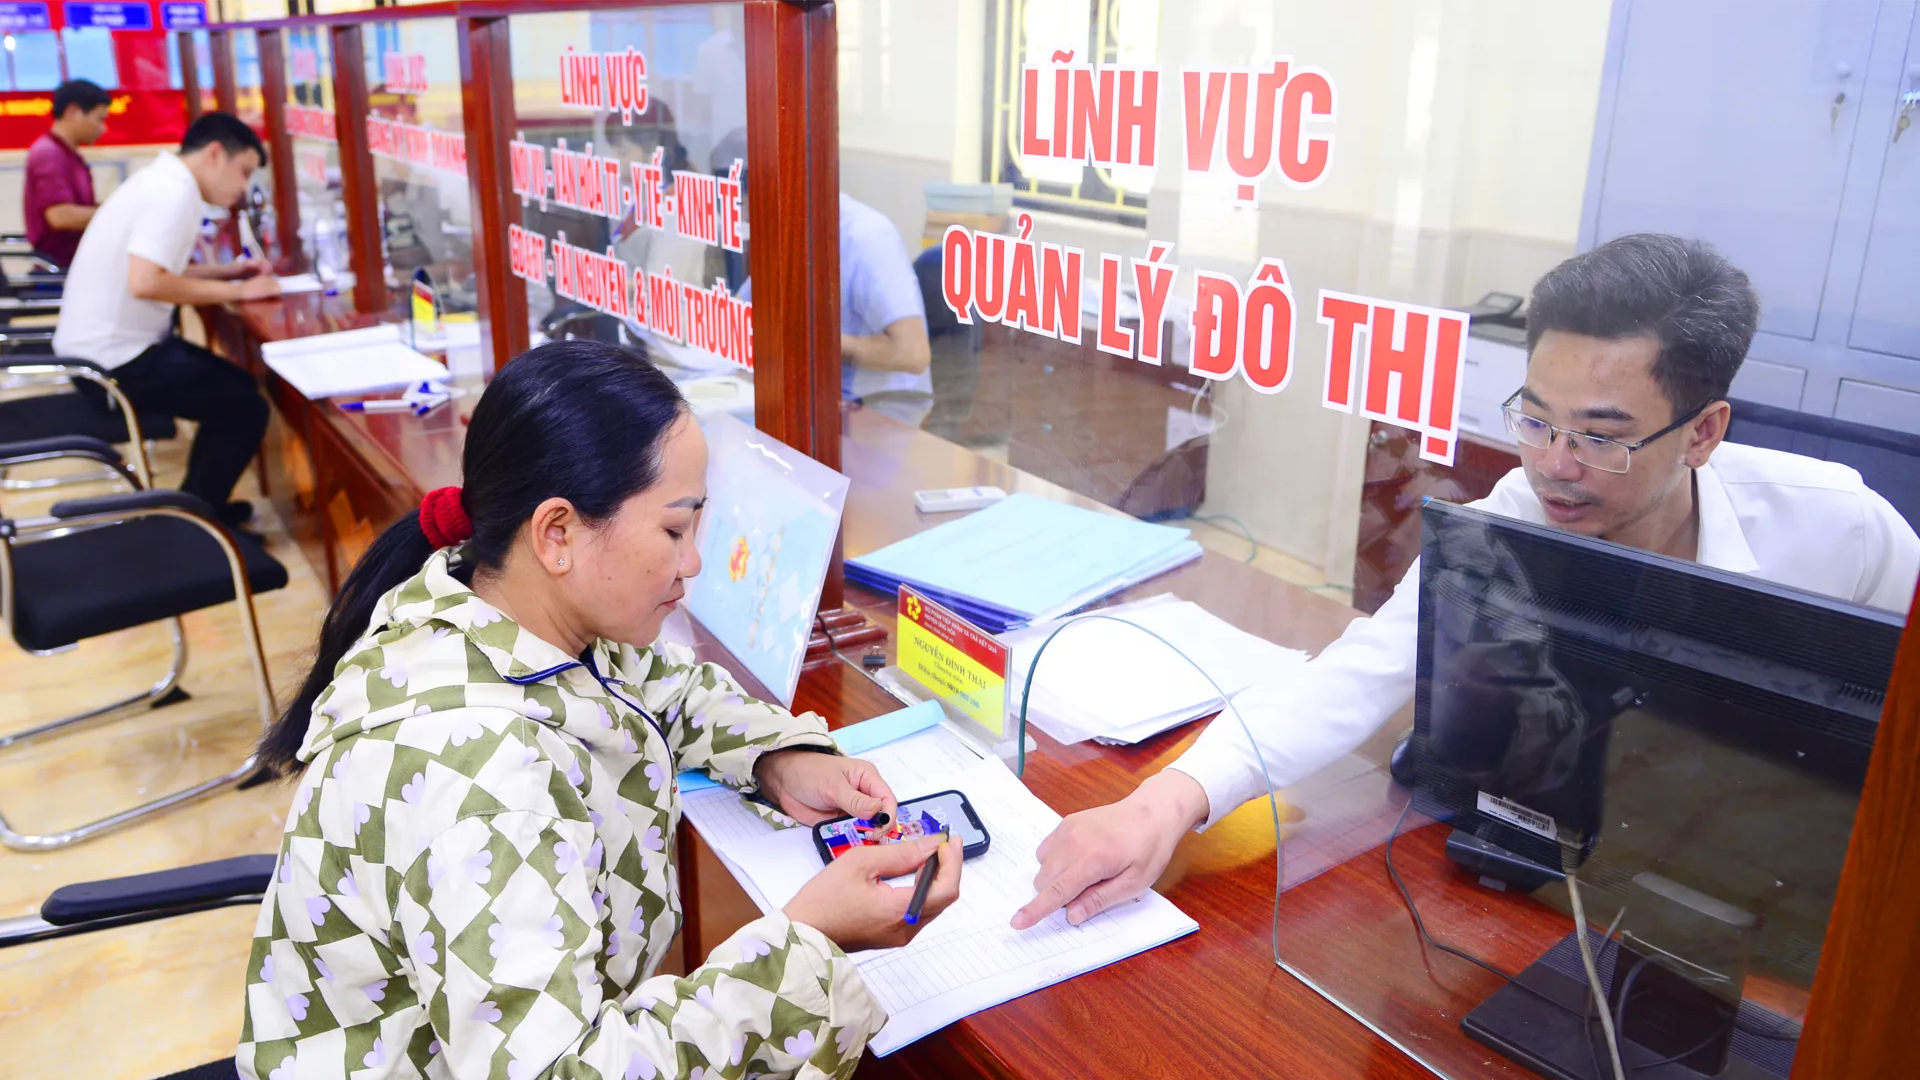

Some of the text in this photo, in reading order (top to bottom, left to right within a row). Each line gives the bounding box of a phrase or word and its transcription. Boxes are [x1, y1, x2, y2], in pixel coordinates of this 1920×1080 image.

[605, 46, 647, 124] VỰC
[1022, 49, 1334, 201] LĨNH VỰC
[631, 162, 643, 225] Y
[643, 147, 664, 230] TẾ
[674, 171, 718, 246] KINH
[718, 159, 743, 253] TẾ
[574, 245, 628, 318] NGUYÊN
[634, 267, 648, 328] &
[649, 266, 683, 342] MÔI
[942, 212, 1466, 461] QUẢN LÝ ĐÔ THỊ
[914, 636, 986, 690] NGUYỄN ĐÌNH THÁI
